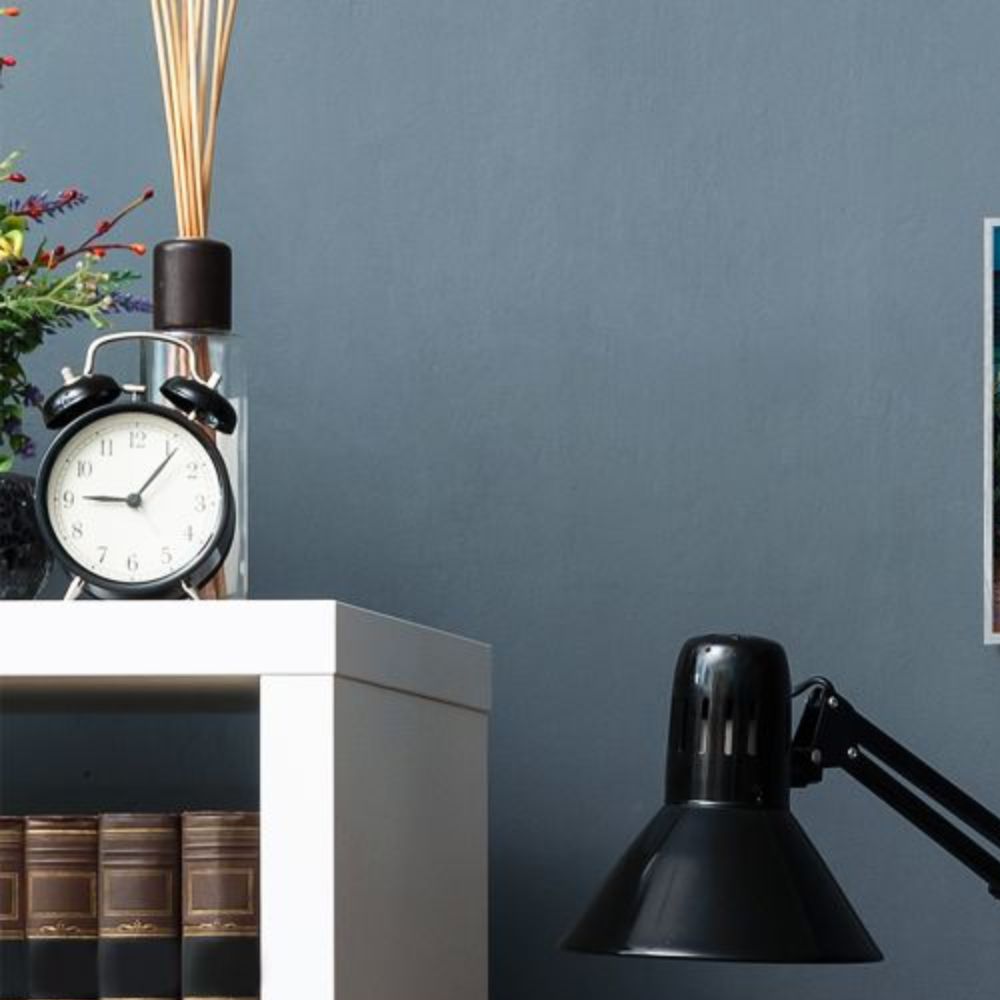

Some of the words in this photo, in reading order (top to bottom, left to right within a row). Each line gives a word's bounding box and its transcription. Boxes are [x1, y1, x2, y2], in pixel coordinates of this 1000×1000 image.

[101, 439, 113, 457] 11
[130, 431, 146, 448] 12
[77, 460, 93, 478] 10
[187, 462, 198, 479] 2
[63, 491, 75, 509] 9
[194, 495, 206, 512] 3
[72, 522, 83, 539] 8
[184, 525, 193, 542] 4
[97, 546, 108, 564] 7
[127, 554, 139, 571] 6
[161, 546, 173, 564] 5
